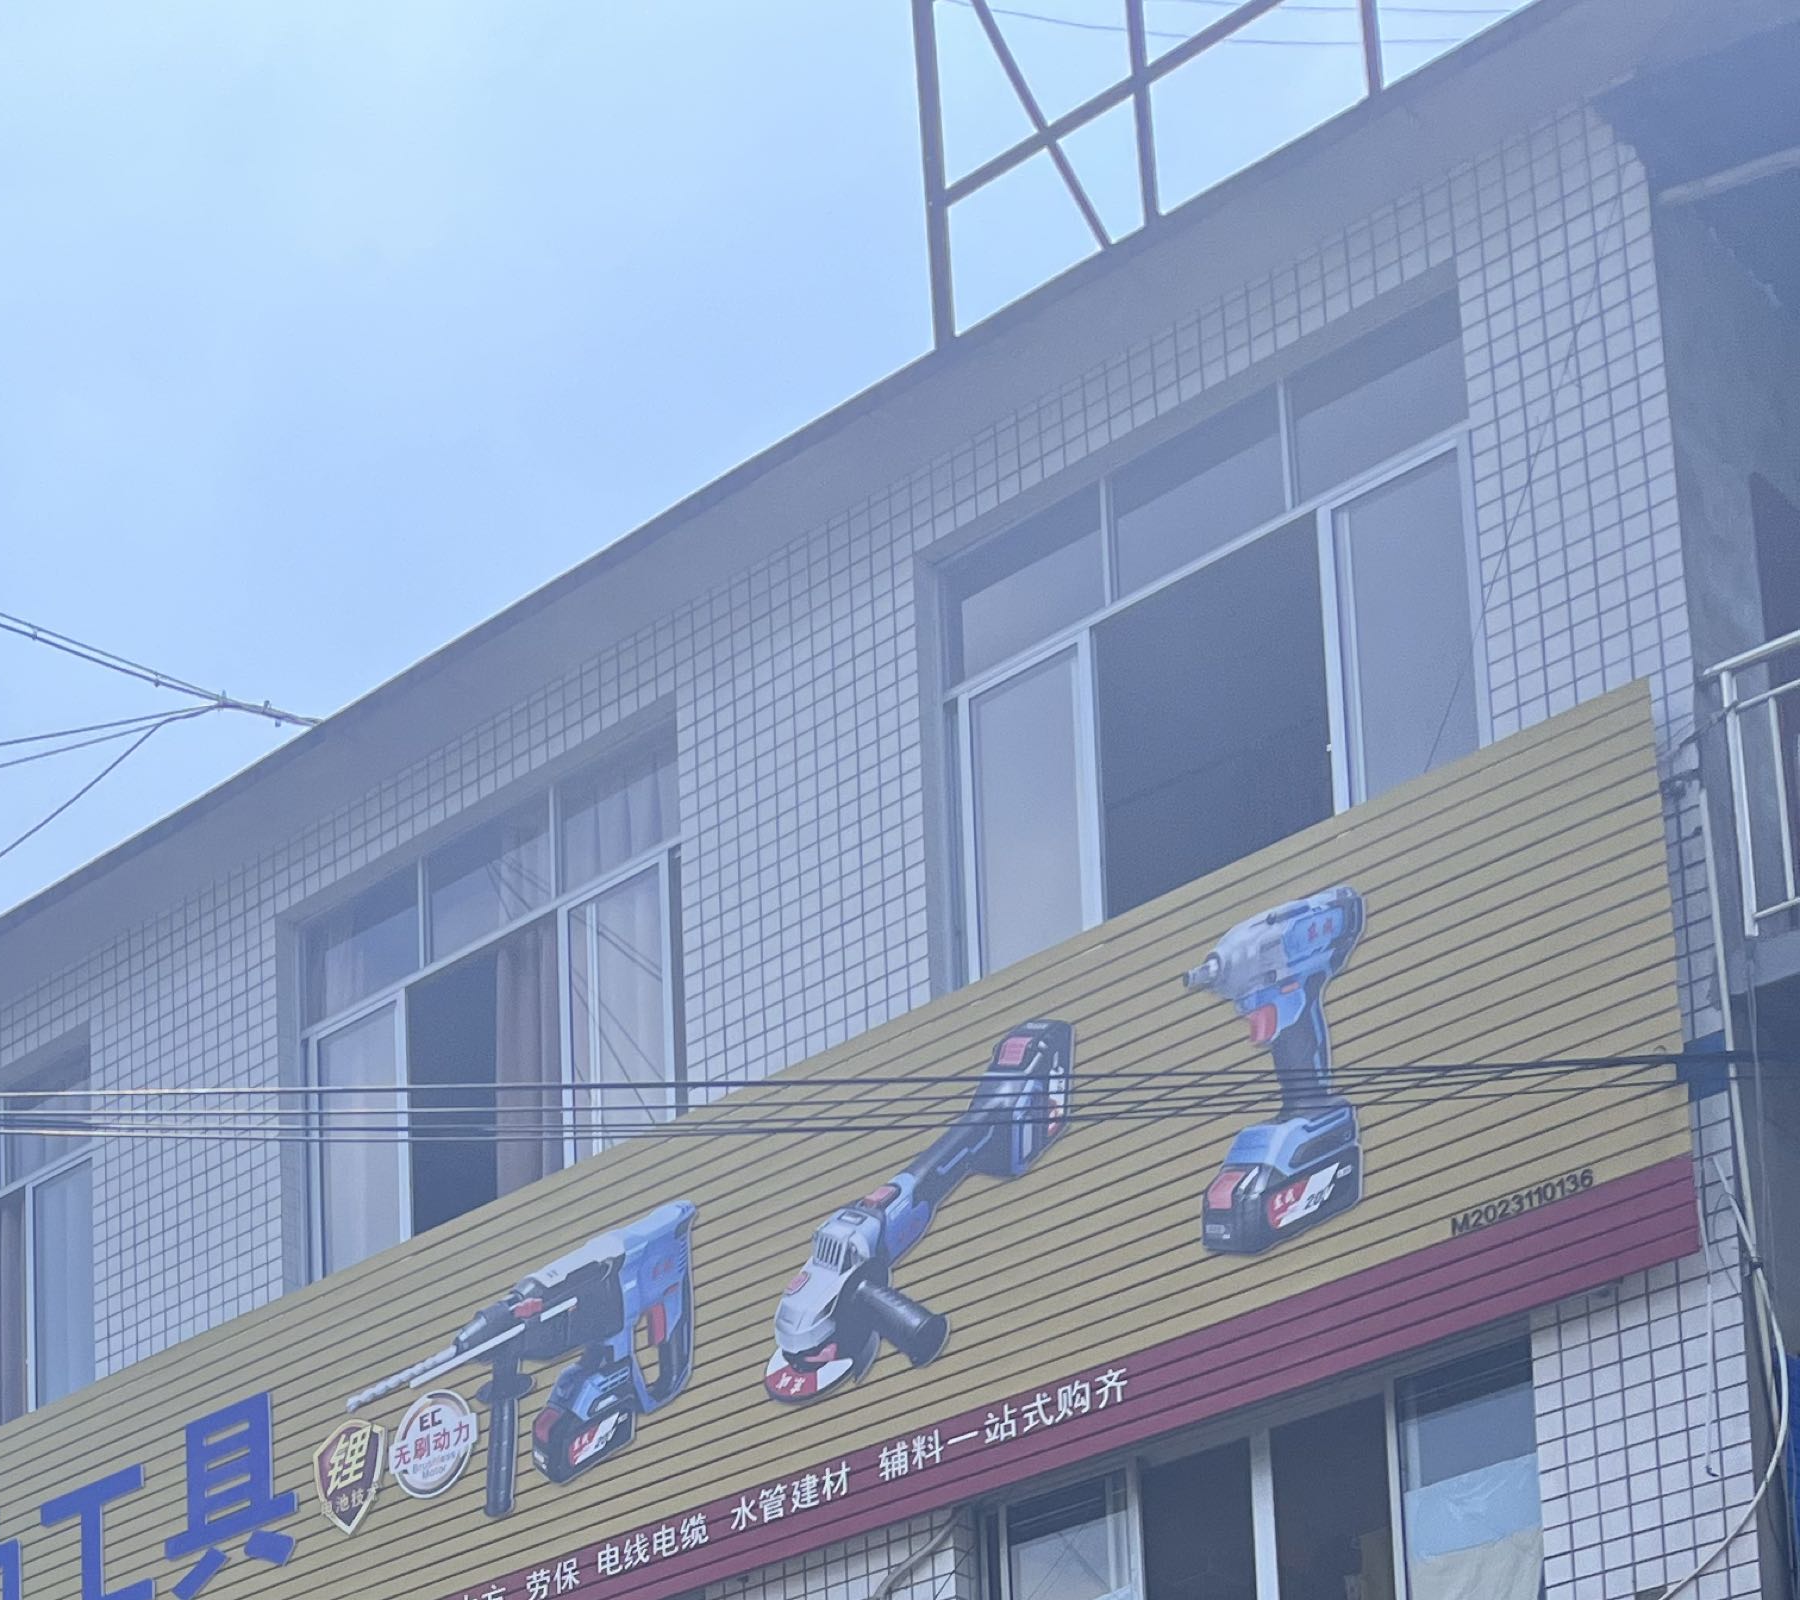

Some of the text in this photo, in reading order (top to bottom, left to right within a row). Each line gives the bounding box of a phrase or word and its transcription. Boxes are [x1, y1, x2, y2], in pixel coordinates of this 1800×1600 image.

[1450, 1168, 1595, 1238] M2023110136
[394, 1421, 470, 1470] 无刷动力
[419, 1407, 443, 1432] EC
[326, 1425, 373, 1498] 锂
[596, 1513, 710, 1577] 电线电缆
[728, 1462, 852, 1532] 水管建材
[877, 1366, 1130, 1481] 辅料一站式购齐
